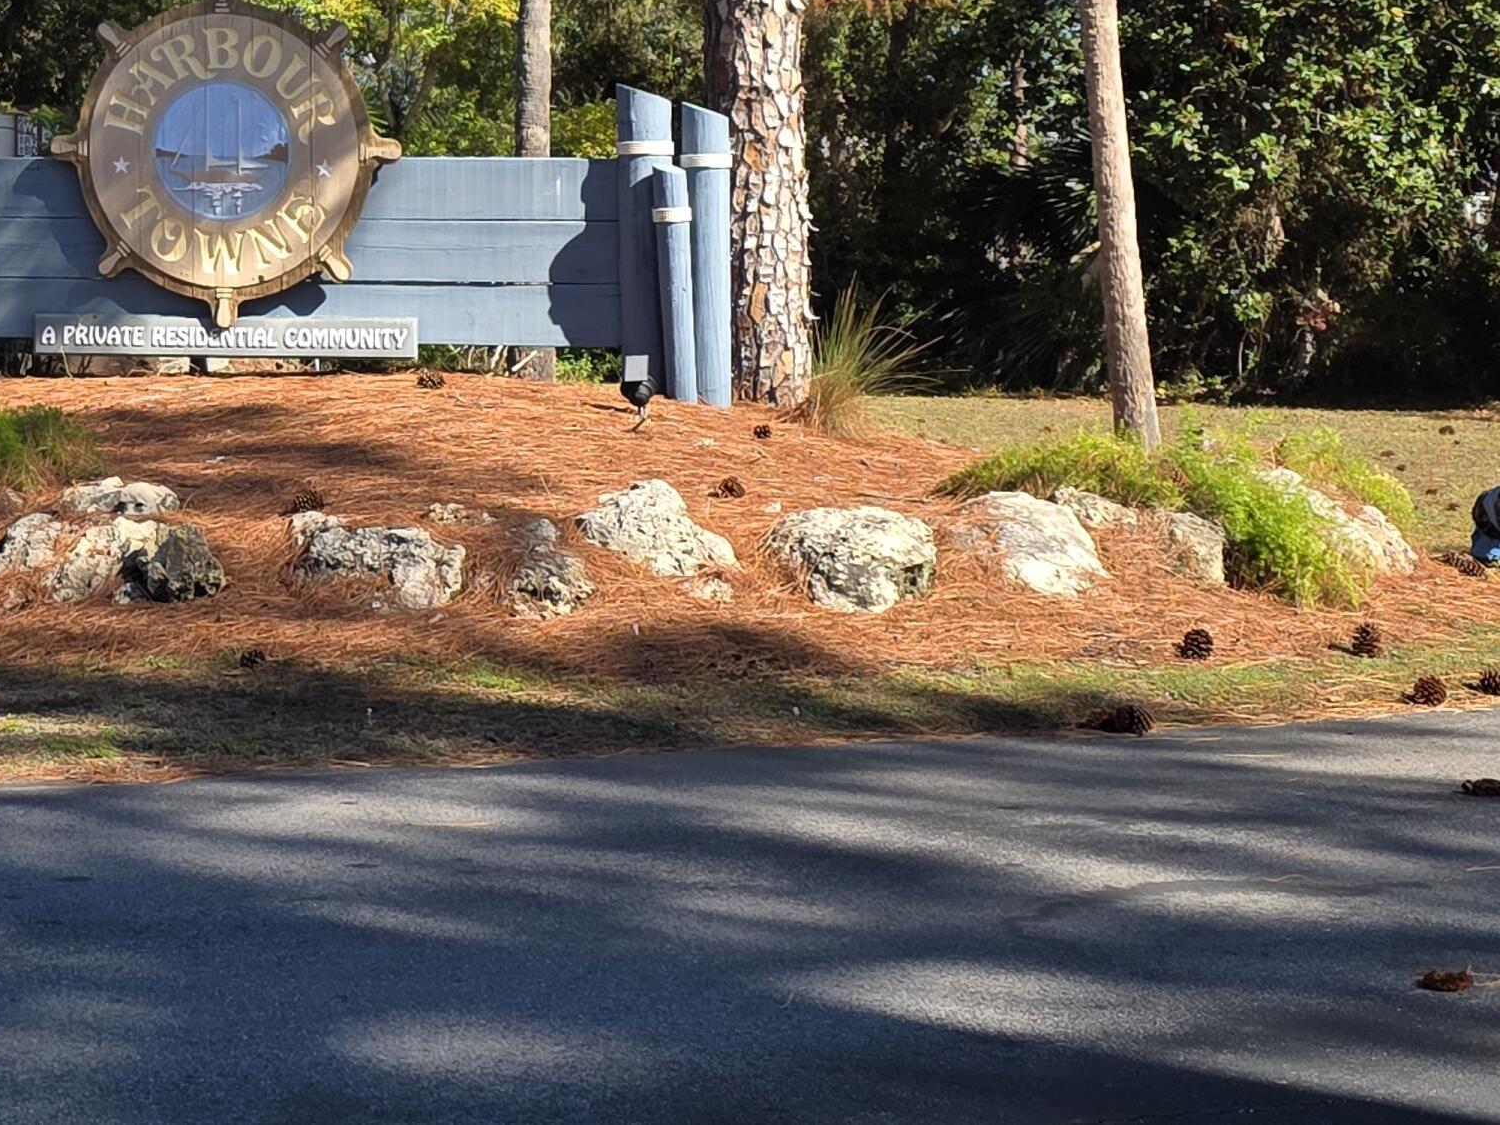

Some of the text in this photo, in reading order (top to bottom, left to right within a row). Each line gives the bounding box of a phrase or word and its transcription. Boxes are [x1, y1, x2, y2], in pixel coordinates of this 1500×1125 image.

[104, 27, 337, 145] HARBOUR
[118, 186, 325, 275] TOWNE
[41, 325, 409, 349] A PRIVATE RESIDENTIAL COMMUNITY
